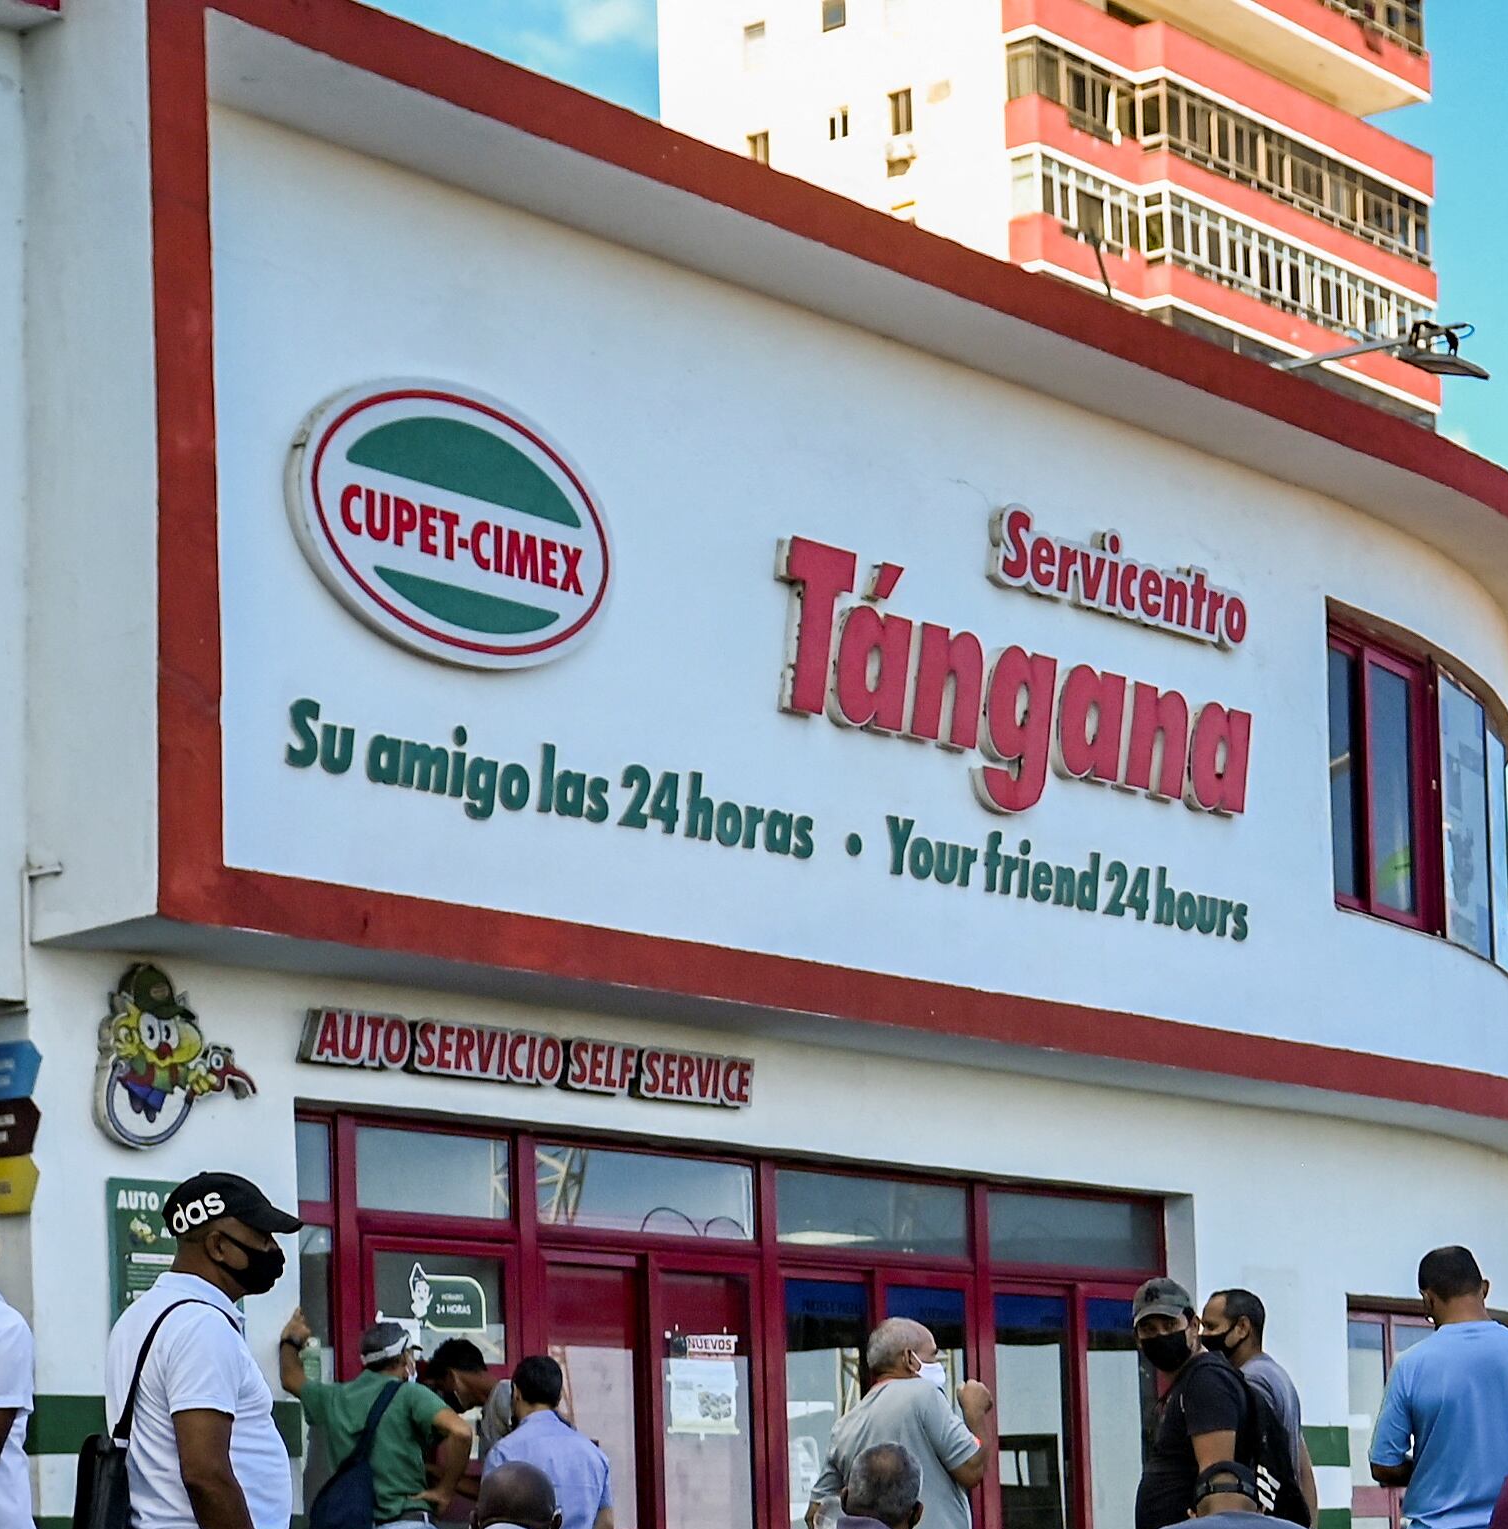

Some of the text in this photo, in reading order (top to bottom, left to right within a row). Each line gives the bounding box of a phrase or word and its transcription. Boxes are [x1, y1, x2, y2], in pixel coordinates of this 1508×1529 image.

[339, 483, 584, 597] CUPET-CIMEX
[1000, 507, 1248, 646] Servicentro
[781, 533, 1252, 815] Tángana
[285, 698, 1249, 942] Su amigo las 24 horas Your friend 24 hours
[315, 1011, 752, 1104] AUTO SERVICIO SELF SERVICE
[116, 1189, 160, 1212] AUTO
[435, 1303, 472, 1316] 24 HORAS
[687, 1337, 733, 1351] NUEVOS
